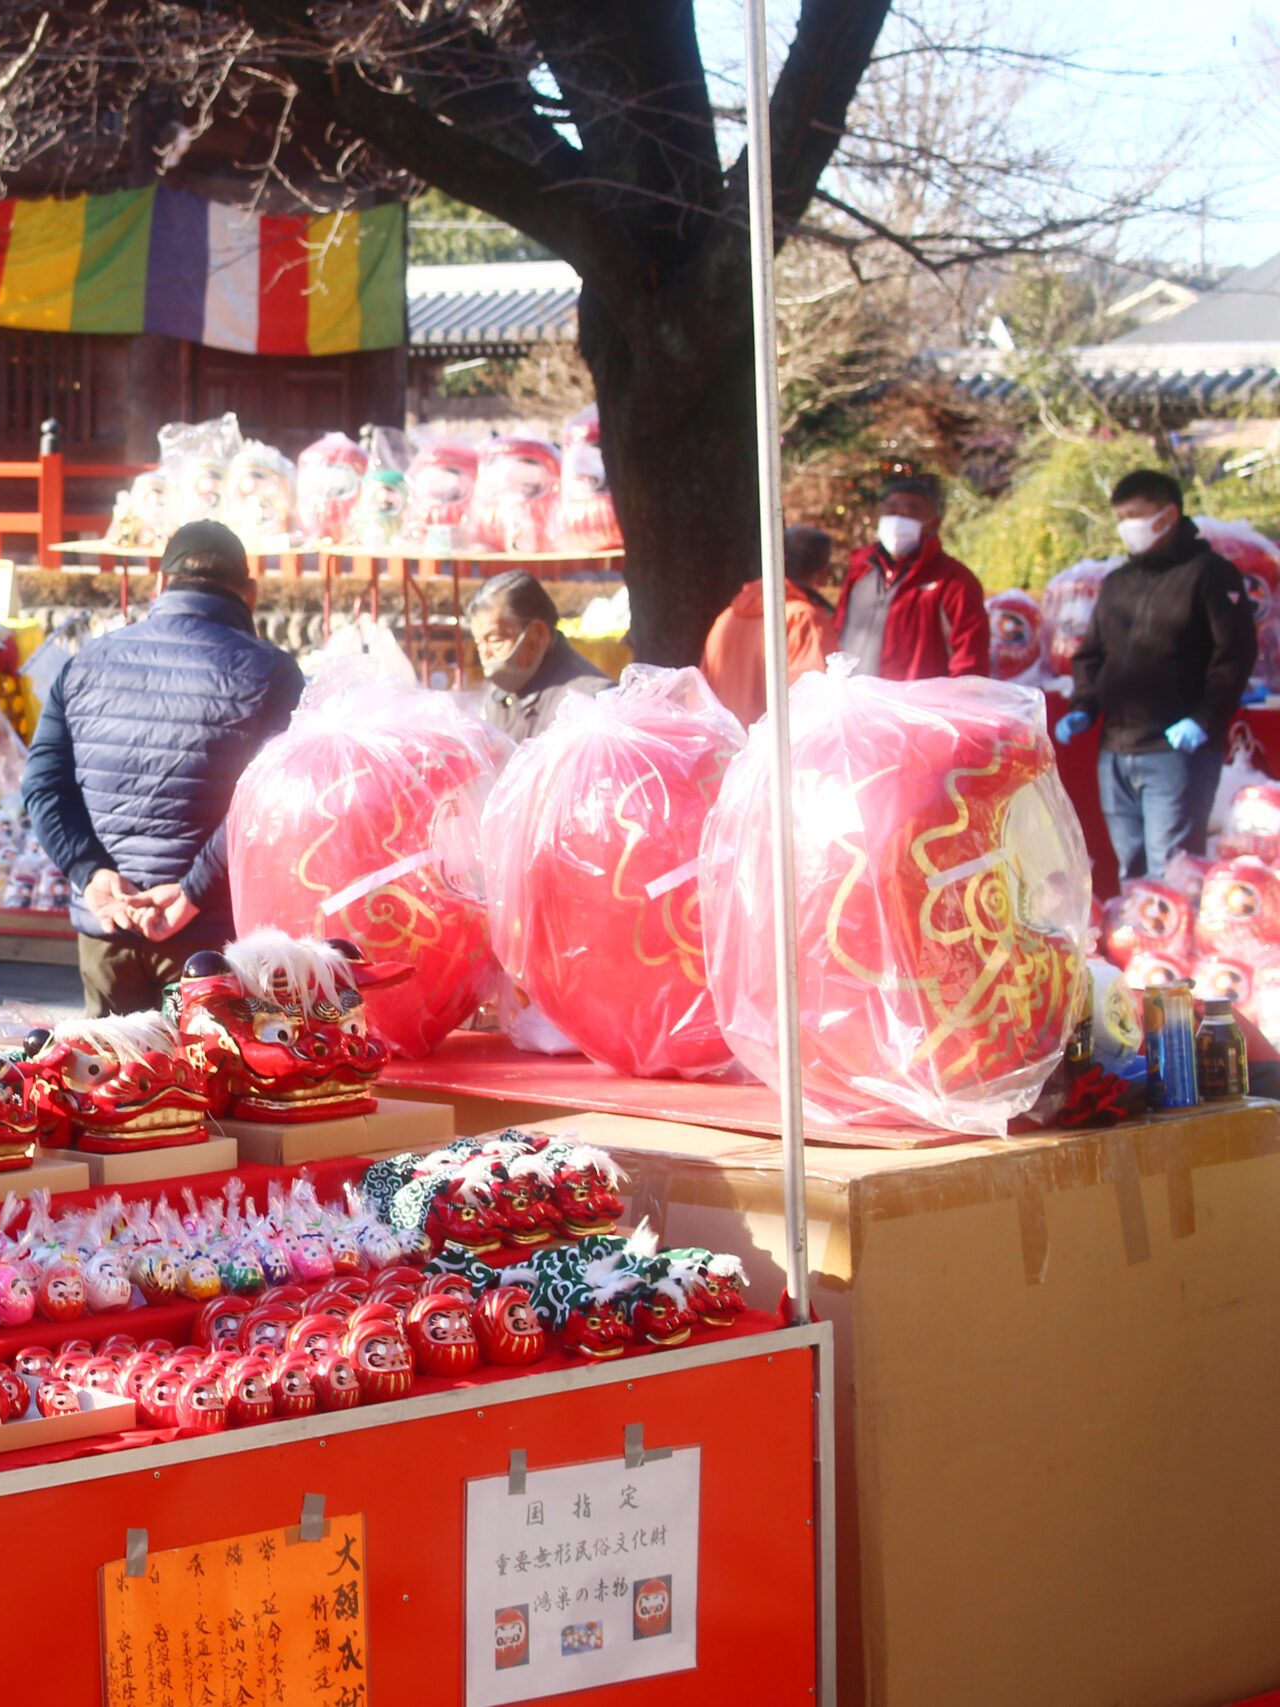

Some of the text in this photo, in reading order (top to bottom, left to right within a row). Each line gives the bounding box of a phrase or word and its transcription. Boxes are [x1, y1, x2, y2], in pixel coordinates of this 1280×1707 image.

[526, 1484, 639, 1526] 国指定
[494, 1524, 668, 1576] 重要無形民俗文化財
[534, 1576, 629, 1613] 鴻巣の赤物
